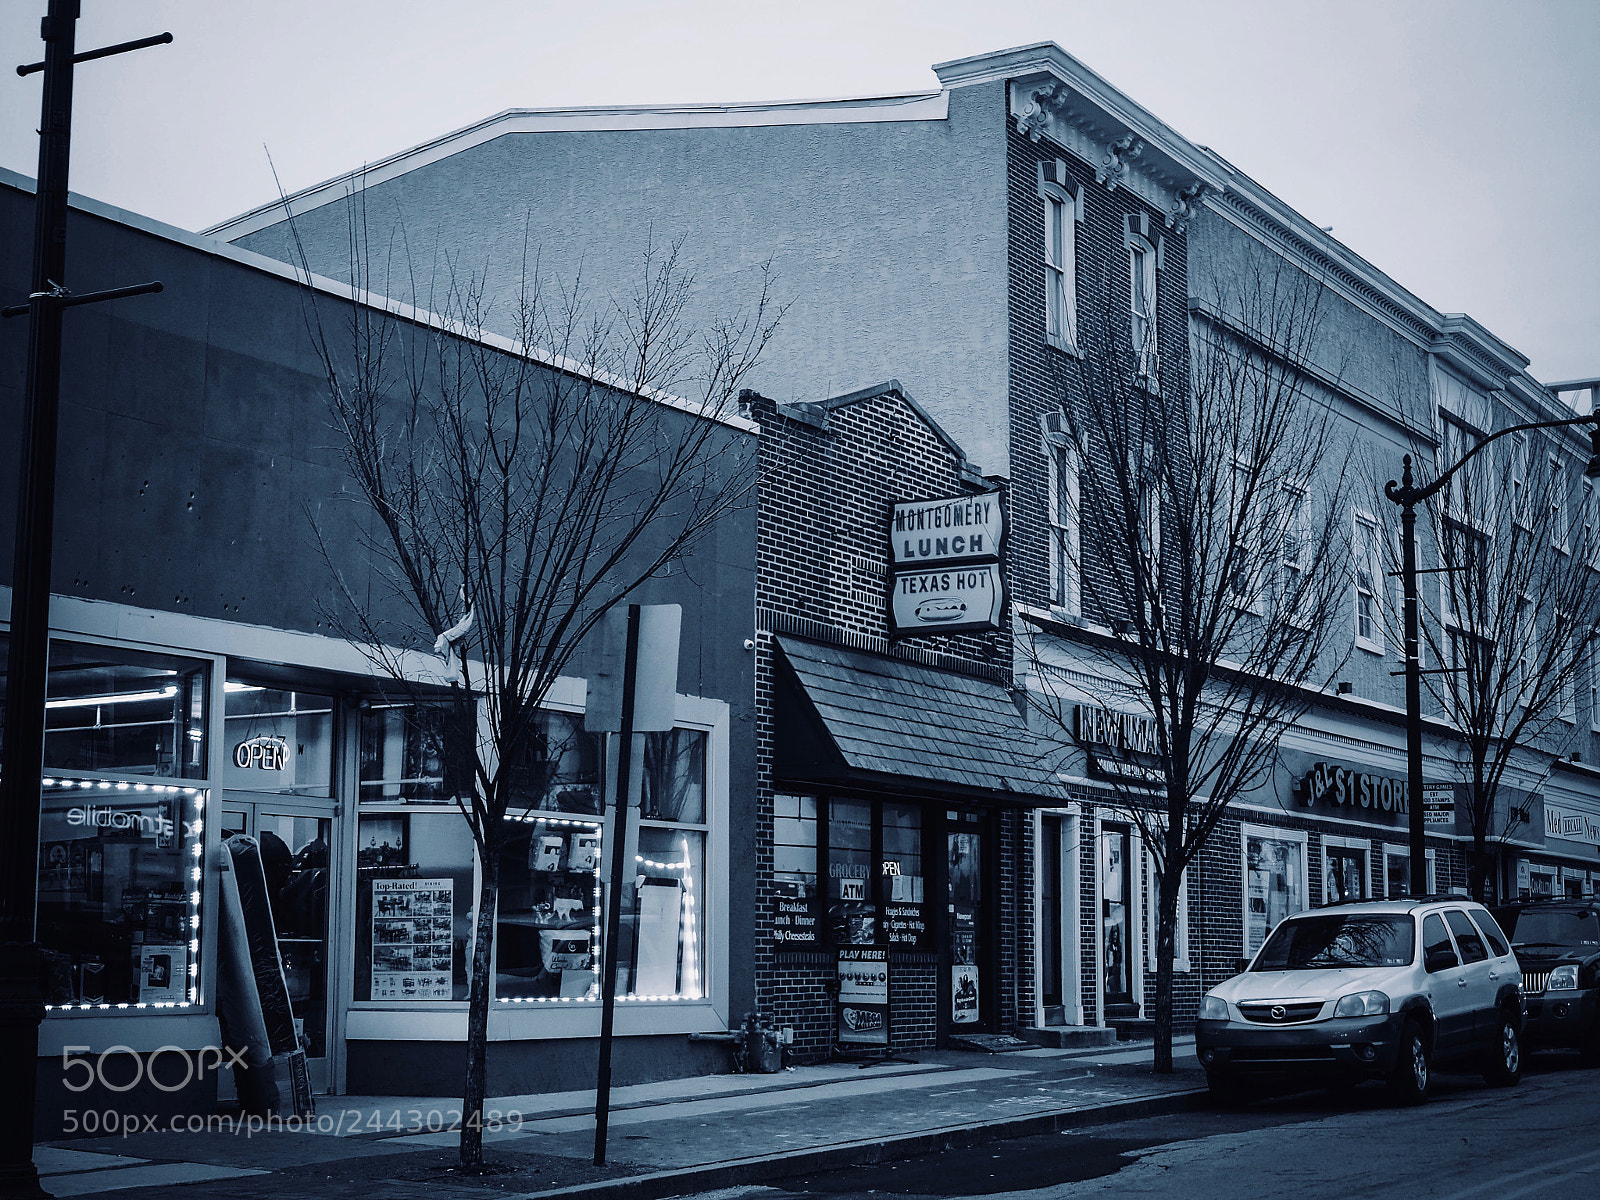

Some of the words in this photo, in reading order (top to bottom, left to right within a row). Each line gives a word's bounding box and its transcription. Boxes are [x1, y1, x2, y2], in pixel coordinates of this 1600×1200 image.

[895, 502, 990, 532] MONTGOMERY
[904, 534, 983, 558] LUNCH
[901, 573, 950, 595] TEXAS
[956, 571, 988, 590] HOT
[1079, 703, 1120, 748] NEW
[236, 742, 286, 771] OPEN
[1307, 762, 1333, 807] J&L
[1546, 809, 1562, 834] Med
[829, 863, 871, 880] GROCERY
[842, 884, 864, 899] ATM
[779, 901, 808, 913] Breakfast
[902, 906, 920, 917] Sandwiches
[795, 915, 816, 926] Dinner
[784, 930, 816, 941] Cheesesteaks
[839, 949, 860, 959] PLAY
[861, 950, 886, 960] HERE!
